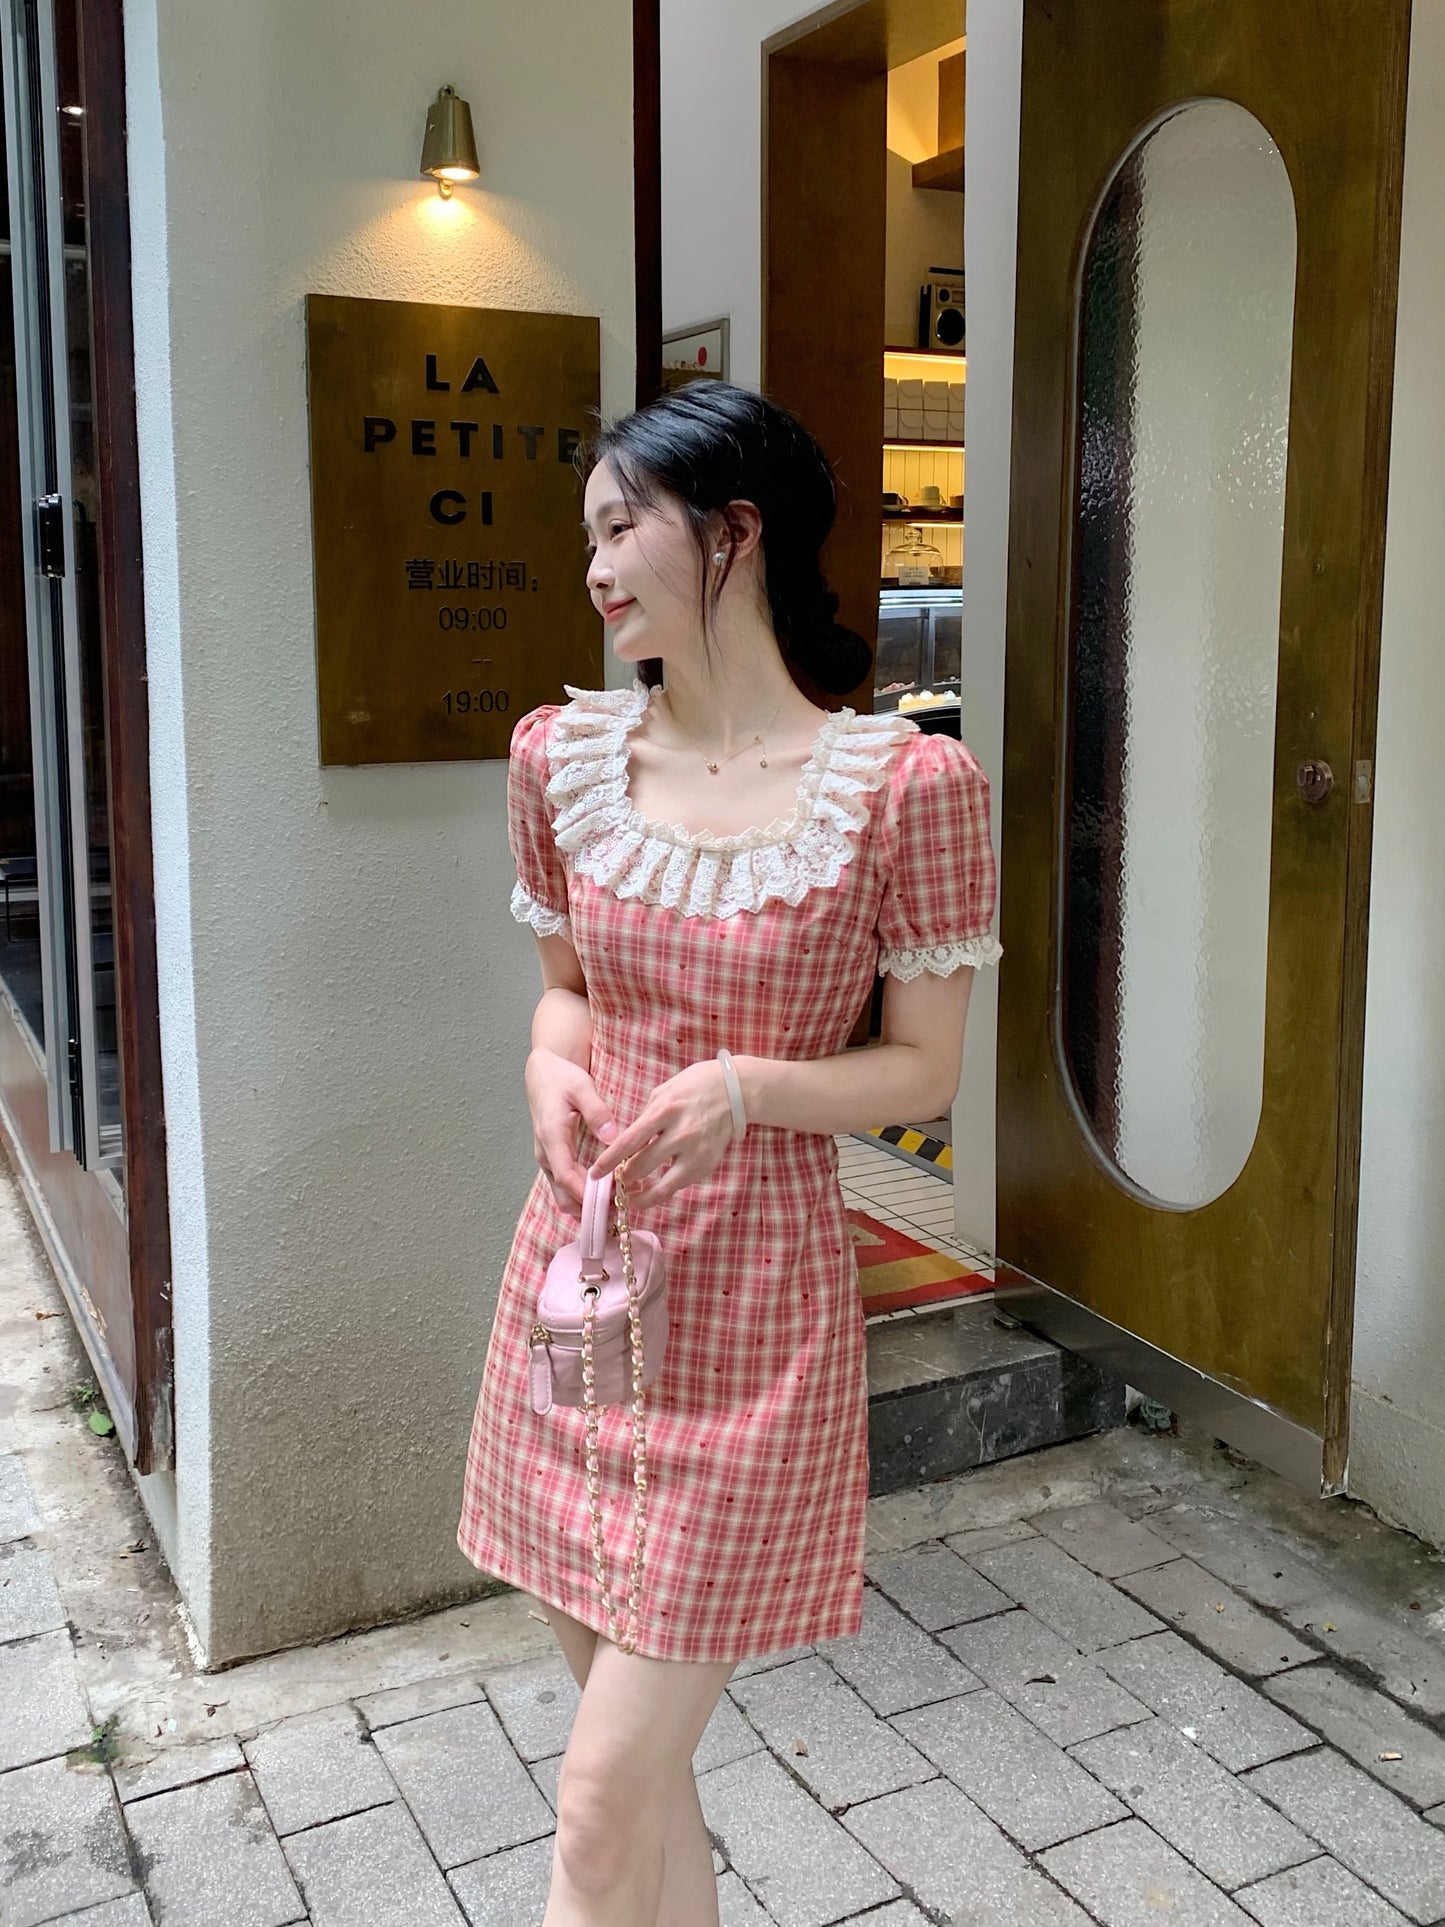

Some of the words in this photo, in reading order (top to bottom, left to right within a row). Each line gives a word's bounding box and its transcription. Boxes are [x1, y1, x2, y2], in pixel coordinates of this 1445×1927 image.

[425, 353, 500, 394] LA
[364, 416, 582, 463] PETITE
[429, 489, 494, 526] CI
[438, 606, 507, 631] 09:00
[441, 689, 510, 714] 19:00
